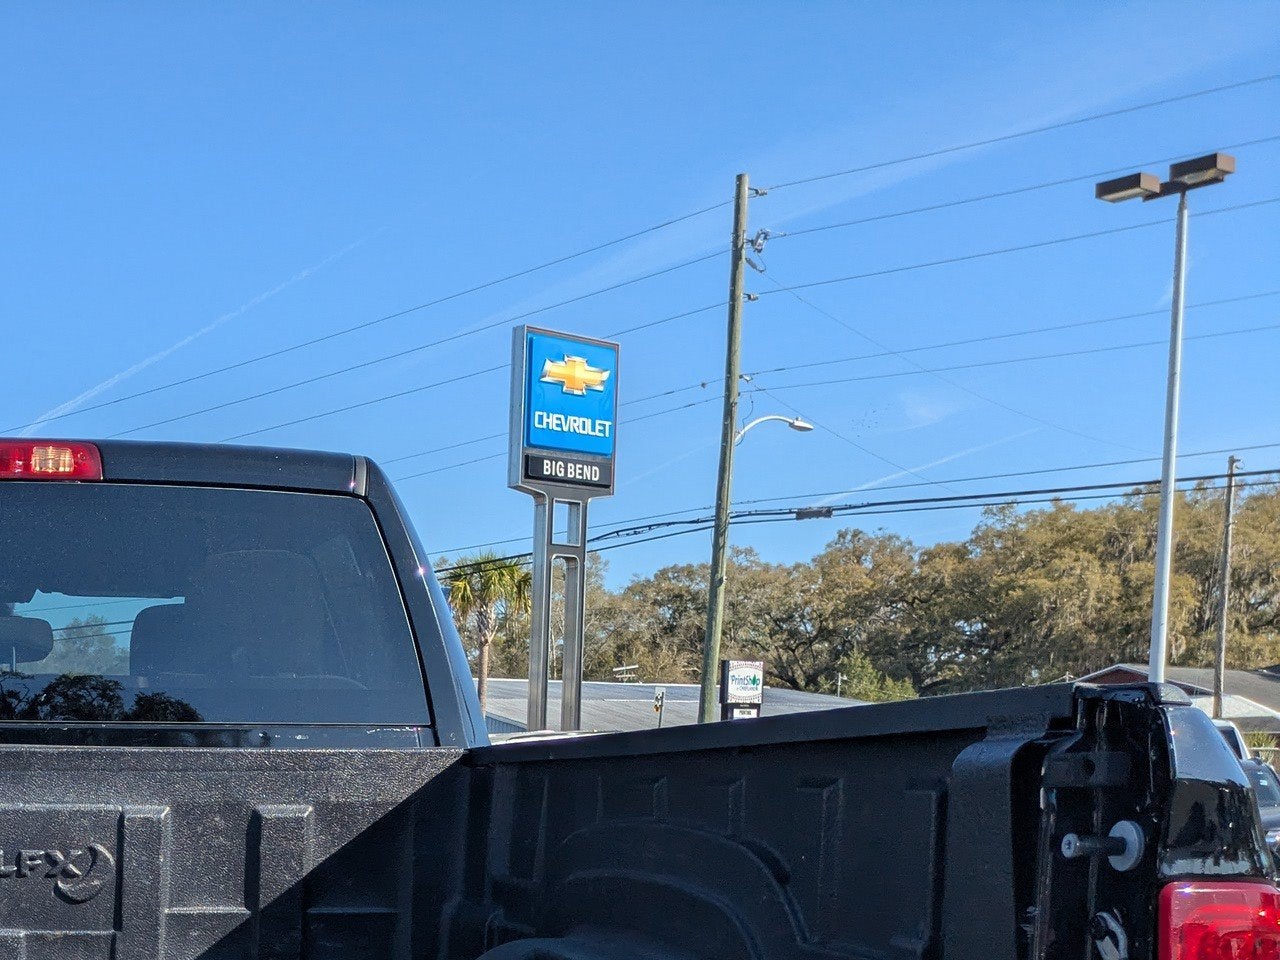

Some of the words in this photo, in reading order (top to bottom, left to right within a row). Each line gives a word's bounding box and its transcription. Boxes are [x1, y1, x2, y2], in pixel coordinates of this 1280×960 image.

[534, 411, 611, 437] CHEVROLET
[543, 459, 565, 477] BIG
[567, 463, 600, 481] BEND
